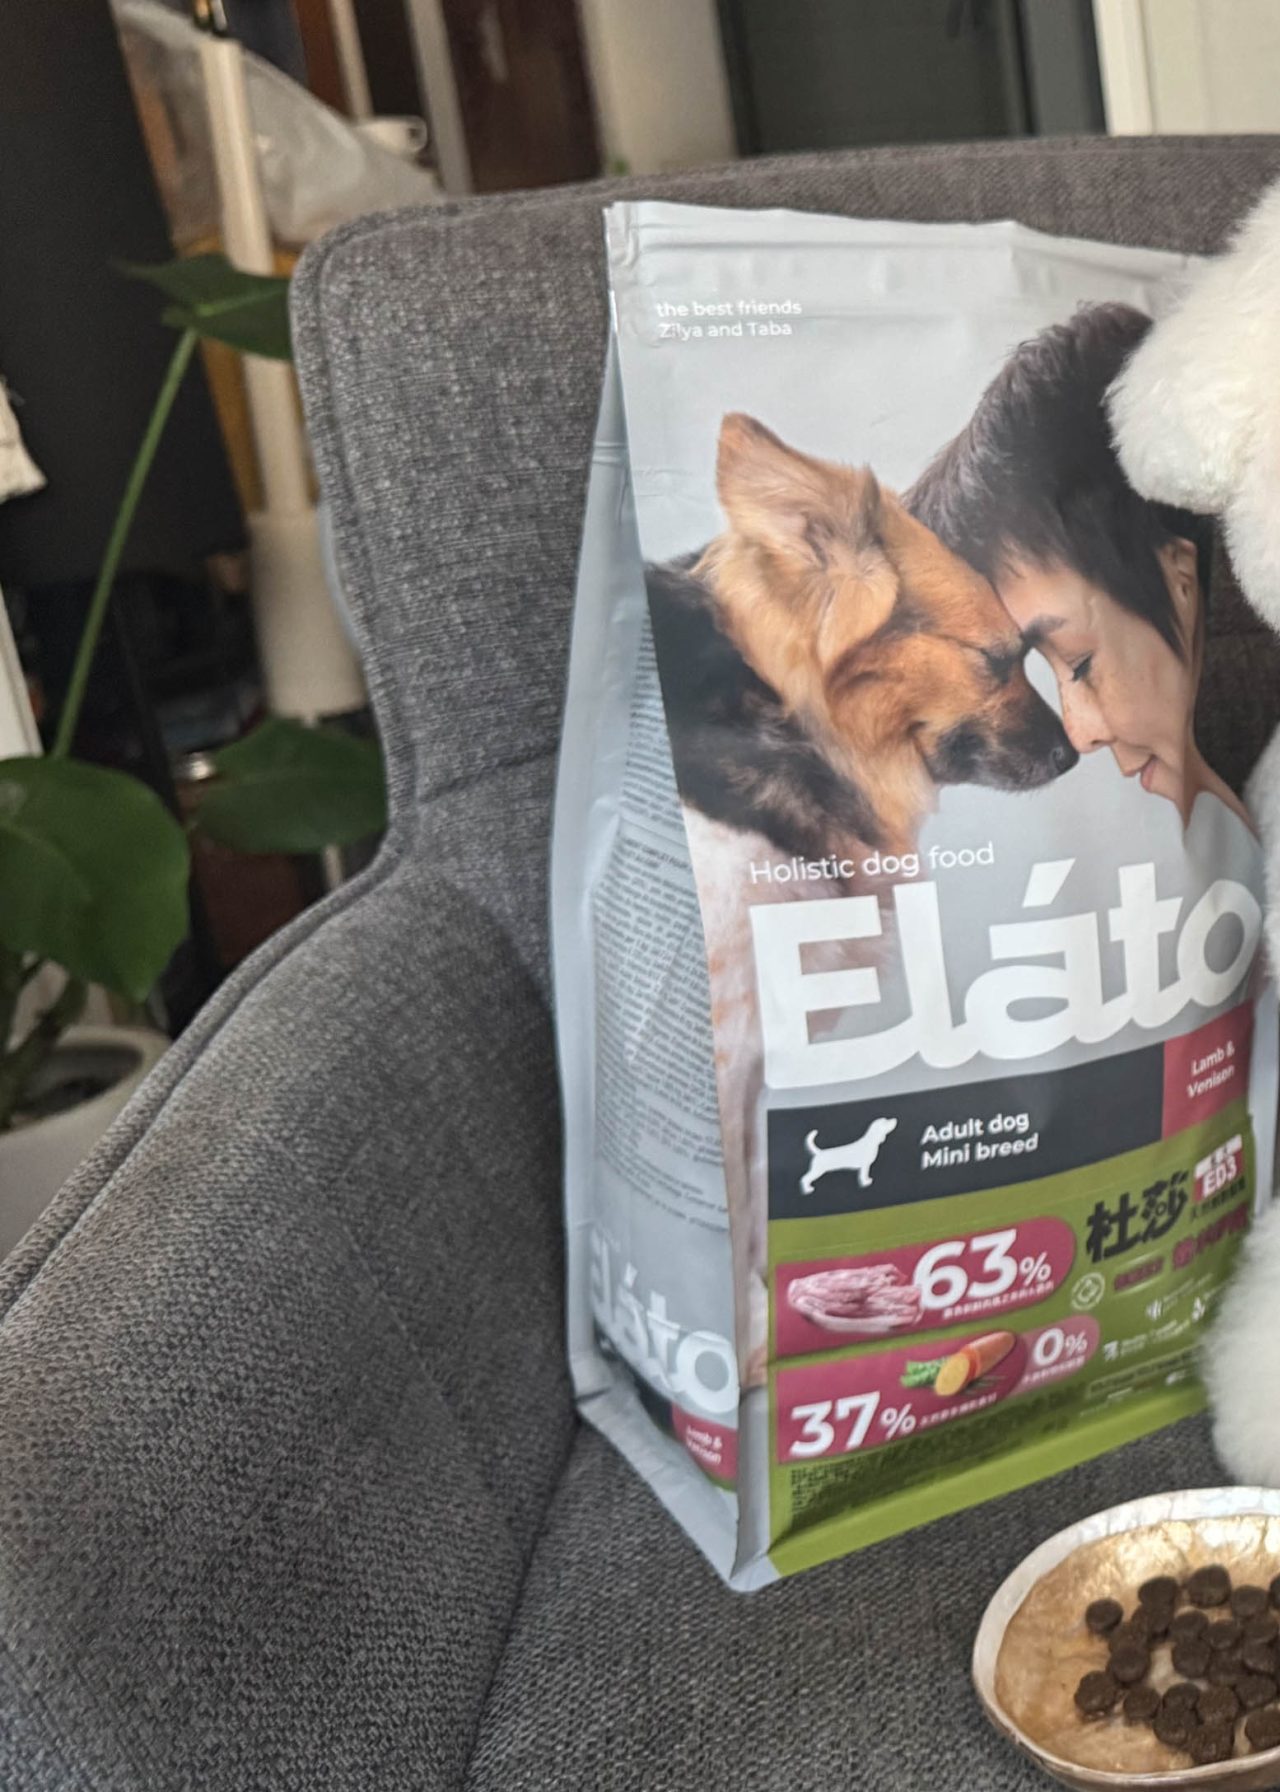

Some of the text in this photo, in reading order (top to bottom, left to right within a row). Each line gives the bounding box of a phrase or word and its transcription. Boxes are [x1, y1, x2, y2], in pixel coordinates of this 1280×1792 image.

[656, 299, 802, 317] the best friends
[707, 320, 742, 337] and
[746, 319, 792, 336] Taba
[750, 841, 994, 884] Holistic dog food
[749, 857, 1263, 1089] Eláto
[1191, 1047, 1225, 1077] Lamb
[1187, 1065, 1235, 1098] Venison
[921, 1113, 1029, 1144] Adult dog
[921, 1132, 1039, 1170] Mini breed
[912, 1228, 1052, 1310] 63%
[1033, 1327, 1088, 1366] 0%
[789, 1391, 916, 1457] 37%
